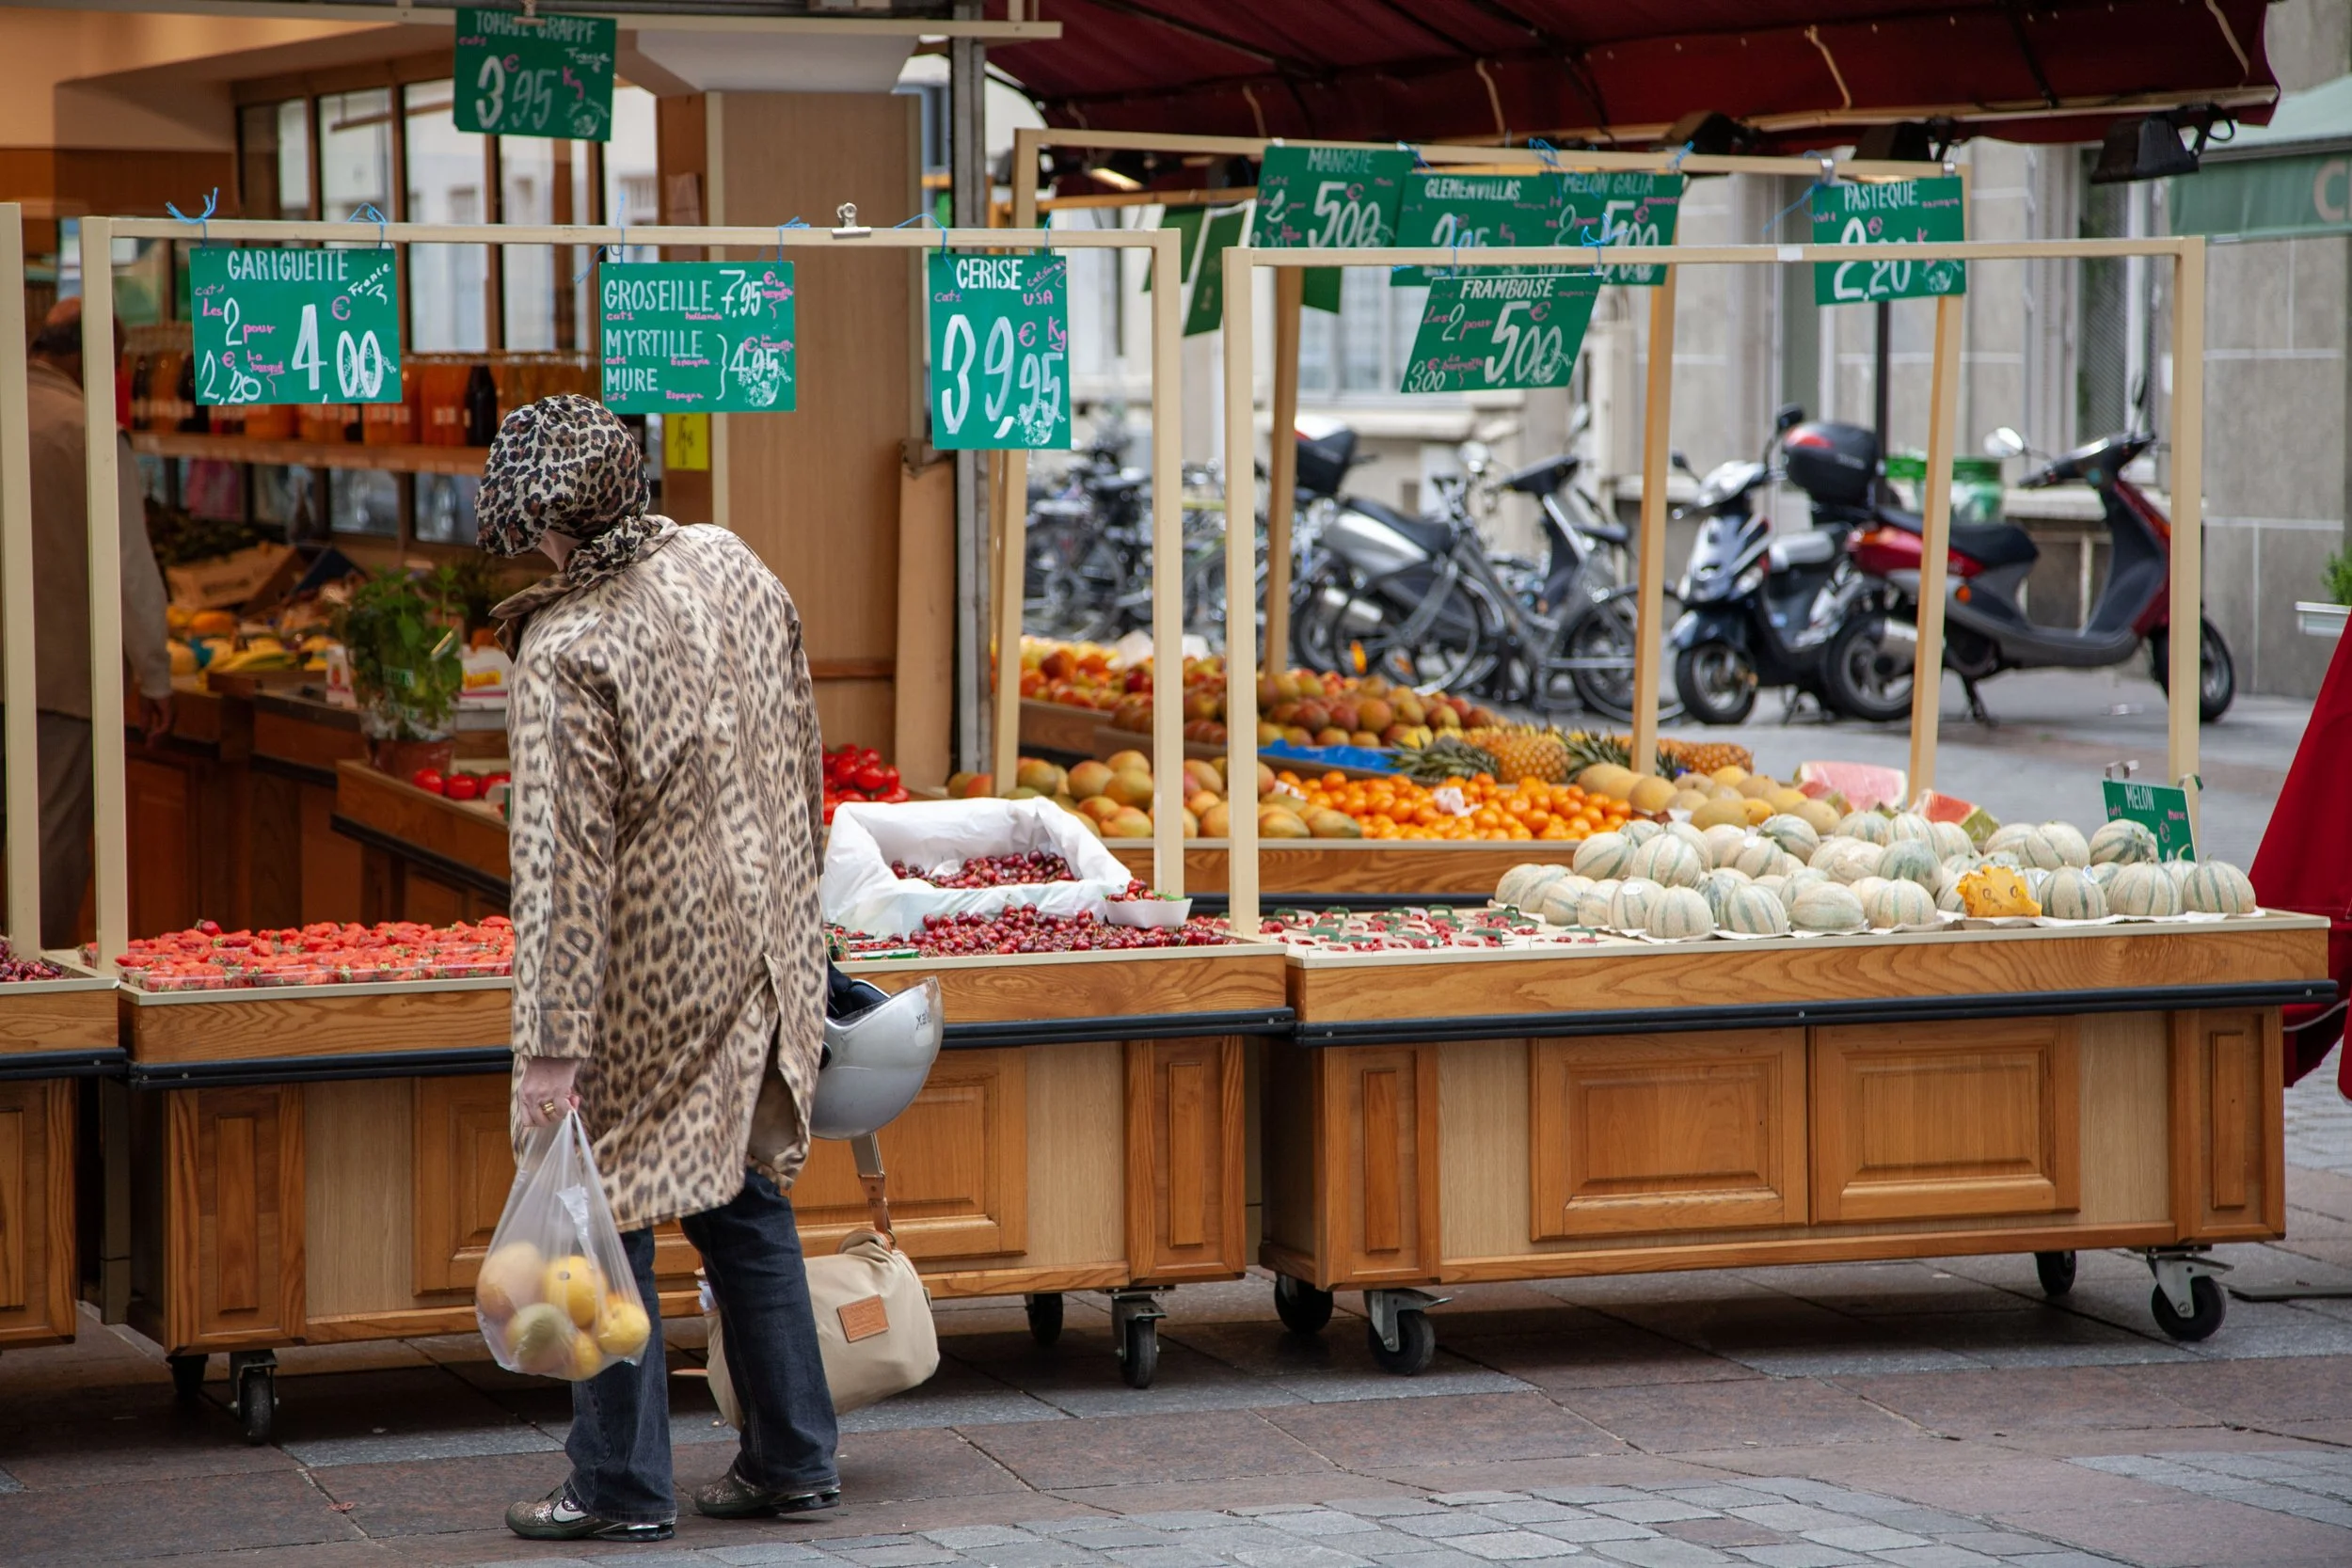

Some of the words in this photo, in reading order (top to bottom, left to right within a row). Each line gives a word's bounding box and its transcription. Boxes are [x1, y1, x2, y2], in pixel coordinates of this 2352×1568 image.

[503, 54, 519, 72] €
[475, 55, 557, 131] 3,95
[1307, 148, 1377, 173] MANGUE
[1844, 179, 1919, 213] PASTEQUE
[2313, 158, 2352, 224] C
[1633, 205, 1650, 224] €
[227, 249, 349, 282] GARIGUETTE
[956, 258, 1024, 291] CERISE
[604, 279, 715, 311] GROSEILLE
[763, 271, 777, 286] €
[1023, 289, 1055, 306] USA
[1460, 278, 1557, 300] FRAMBOISE
[202, 298, 224, 317] Les
[331, 295, 352, 321] €
[1423, 306, 1450, 325] Les
[1442, 303, 1466, 341] 2
[1459, 320, 1493, 341] pour
[1530, 301, 1551, 322] €
[223, 296, 244, 347] 2
[243, 324, 277, 344] pour
[1018, 321, 1037, 348] €
[292, 303, 385, 404] 4,00
[605, 329, 704, 358] MYRTILLE
[743, 336, 759, 353] €
[221, 351, 236, 368] €
[1426, 358, 1440, 372] €
[605, 368, 660, 393] MURE
[2124, 784, 2156, 813] MELON
